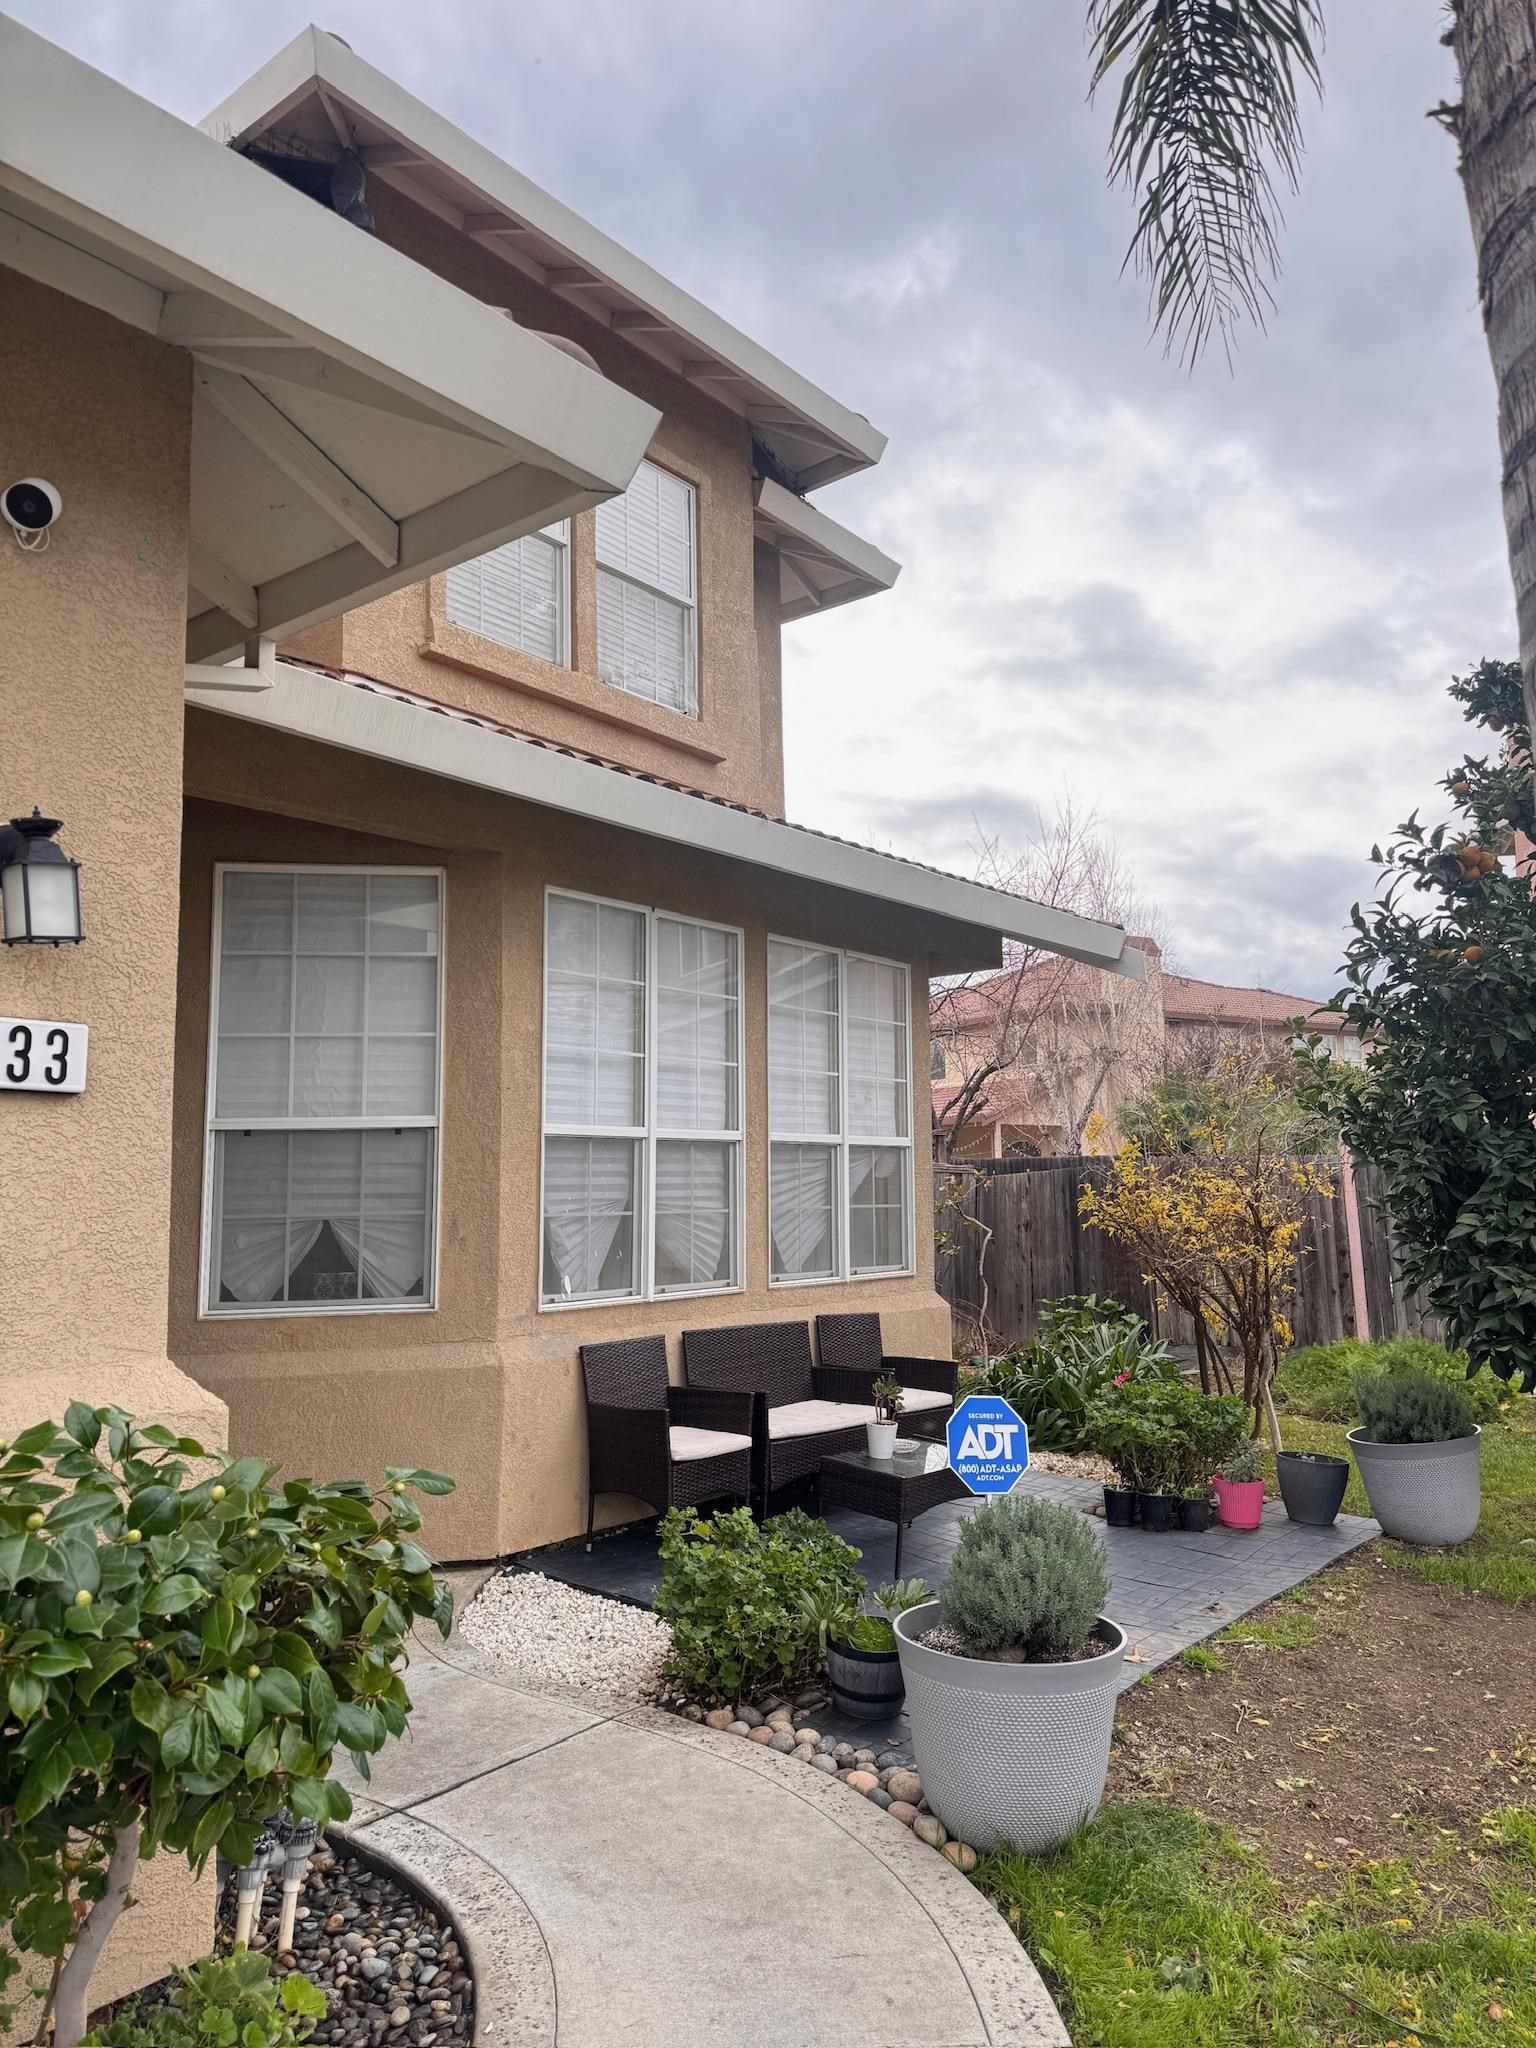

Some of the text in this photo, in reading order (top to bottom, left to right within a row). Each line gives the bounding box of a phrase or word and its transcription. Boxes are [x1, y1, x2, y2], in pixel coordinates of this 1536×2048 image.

[6, 1025, 69, 1085] 33
[956, 1424, 1019, 1460] ADT
[958, 1464, 1022, 1474] (800) ADT-ASAP
